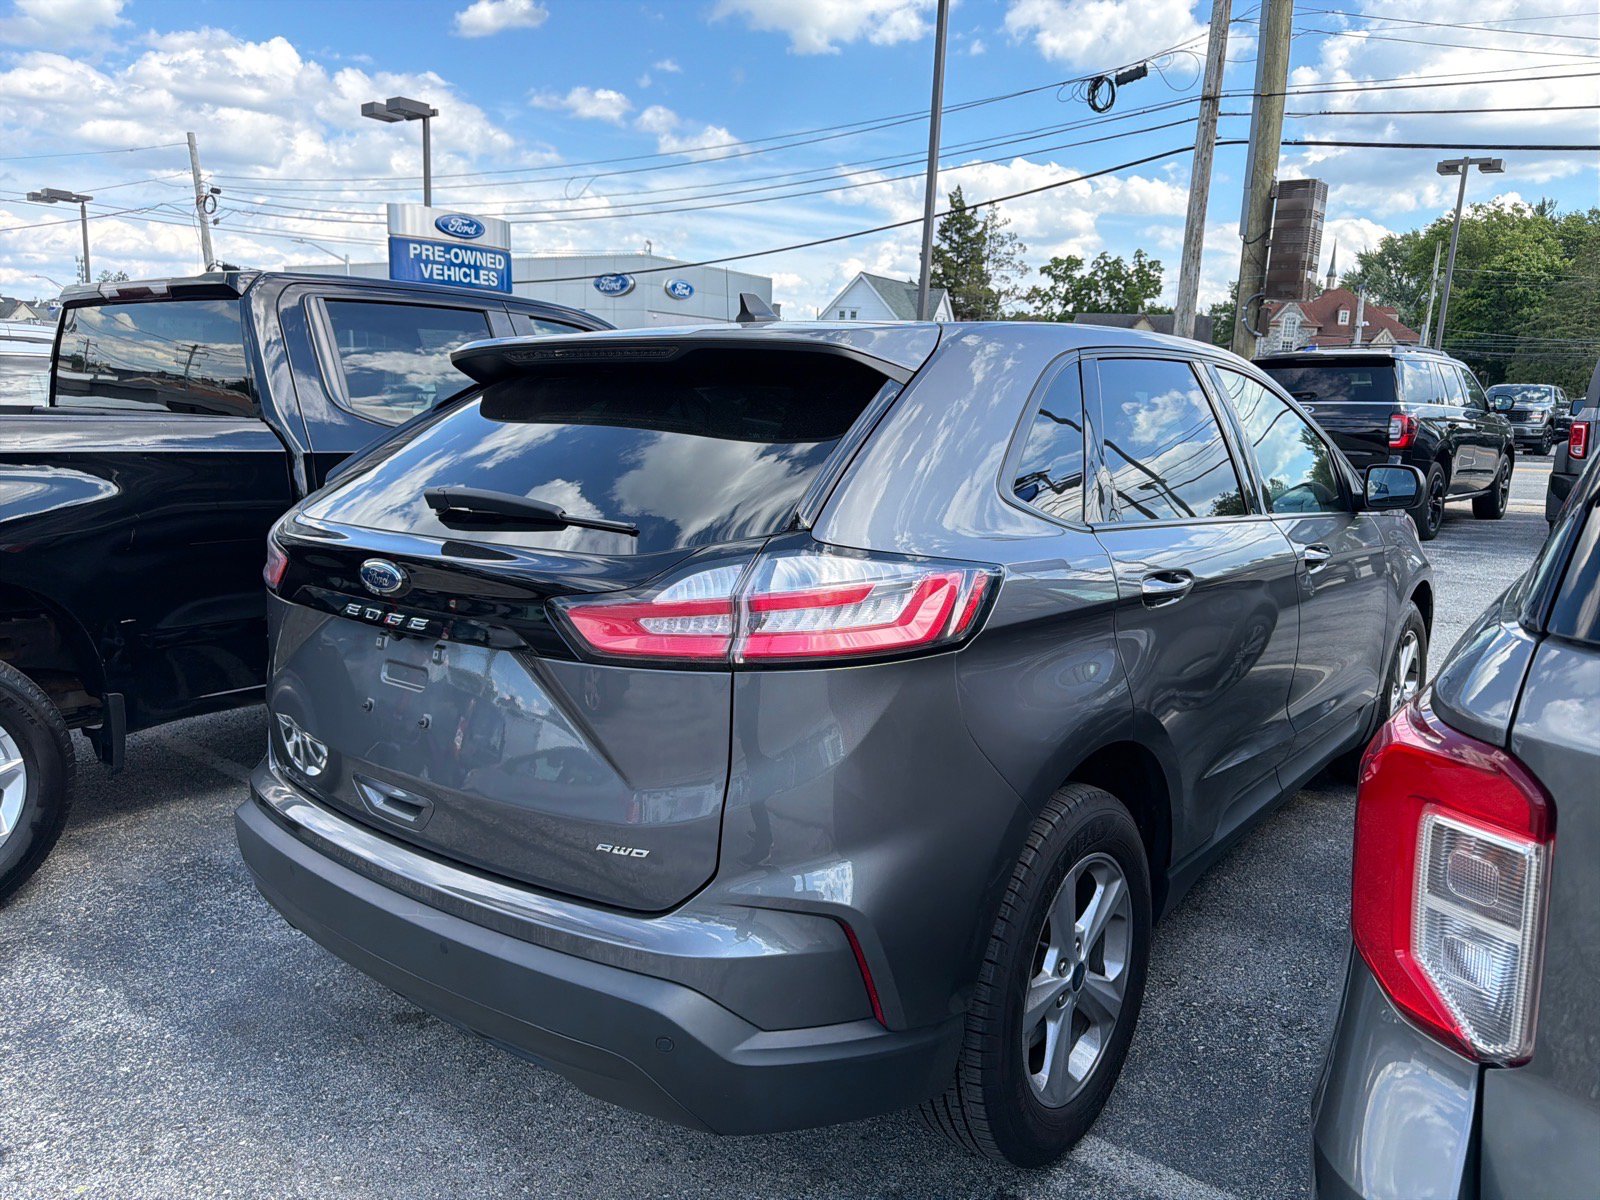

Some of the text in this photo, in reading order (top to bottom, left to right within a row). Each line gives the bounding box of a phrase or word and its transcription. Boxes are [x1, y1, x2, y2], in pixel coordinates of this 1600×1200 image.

[448, 217, 477, 235] Ford
[408, 243, 505, 270] PRE-OWNED
[419, 262, 499, 287] VEHICLES
[599, 276, 622, 291] Ford
[367, 568, 390, 586] Ford
[345, 603, 430, 631] EDGE
[595, 843, 650, 858] AWD
